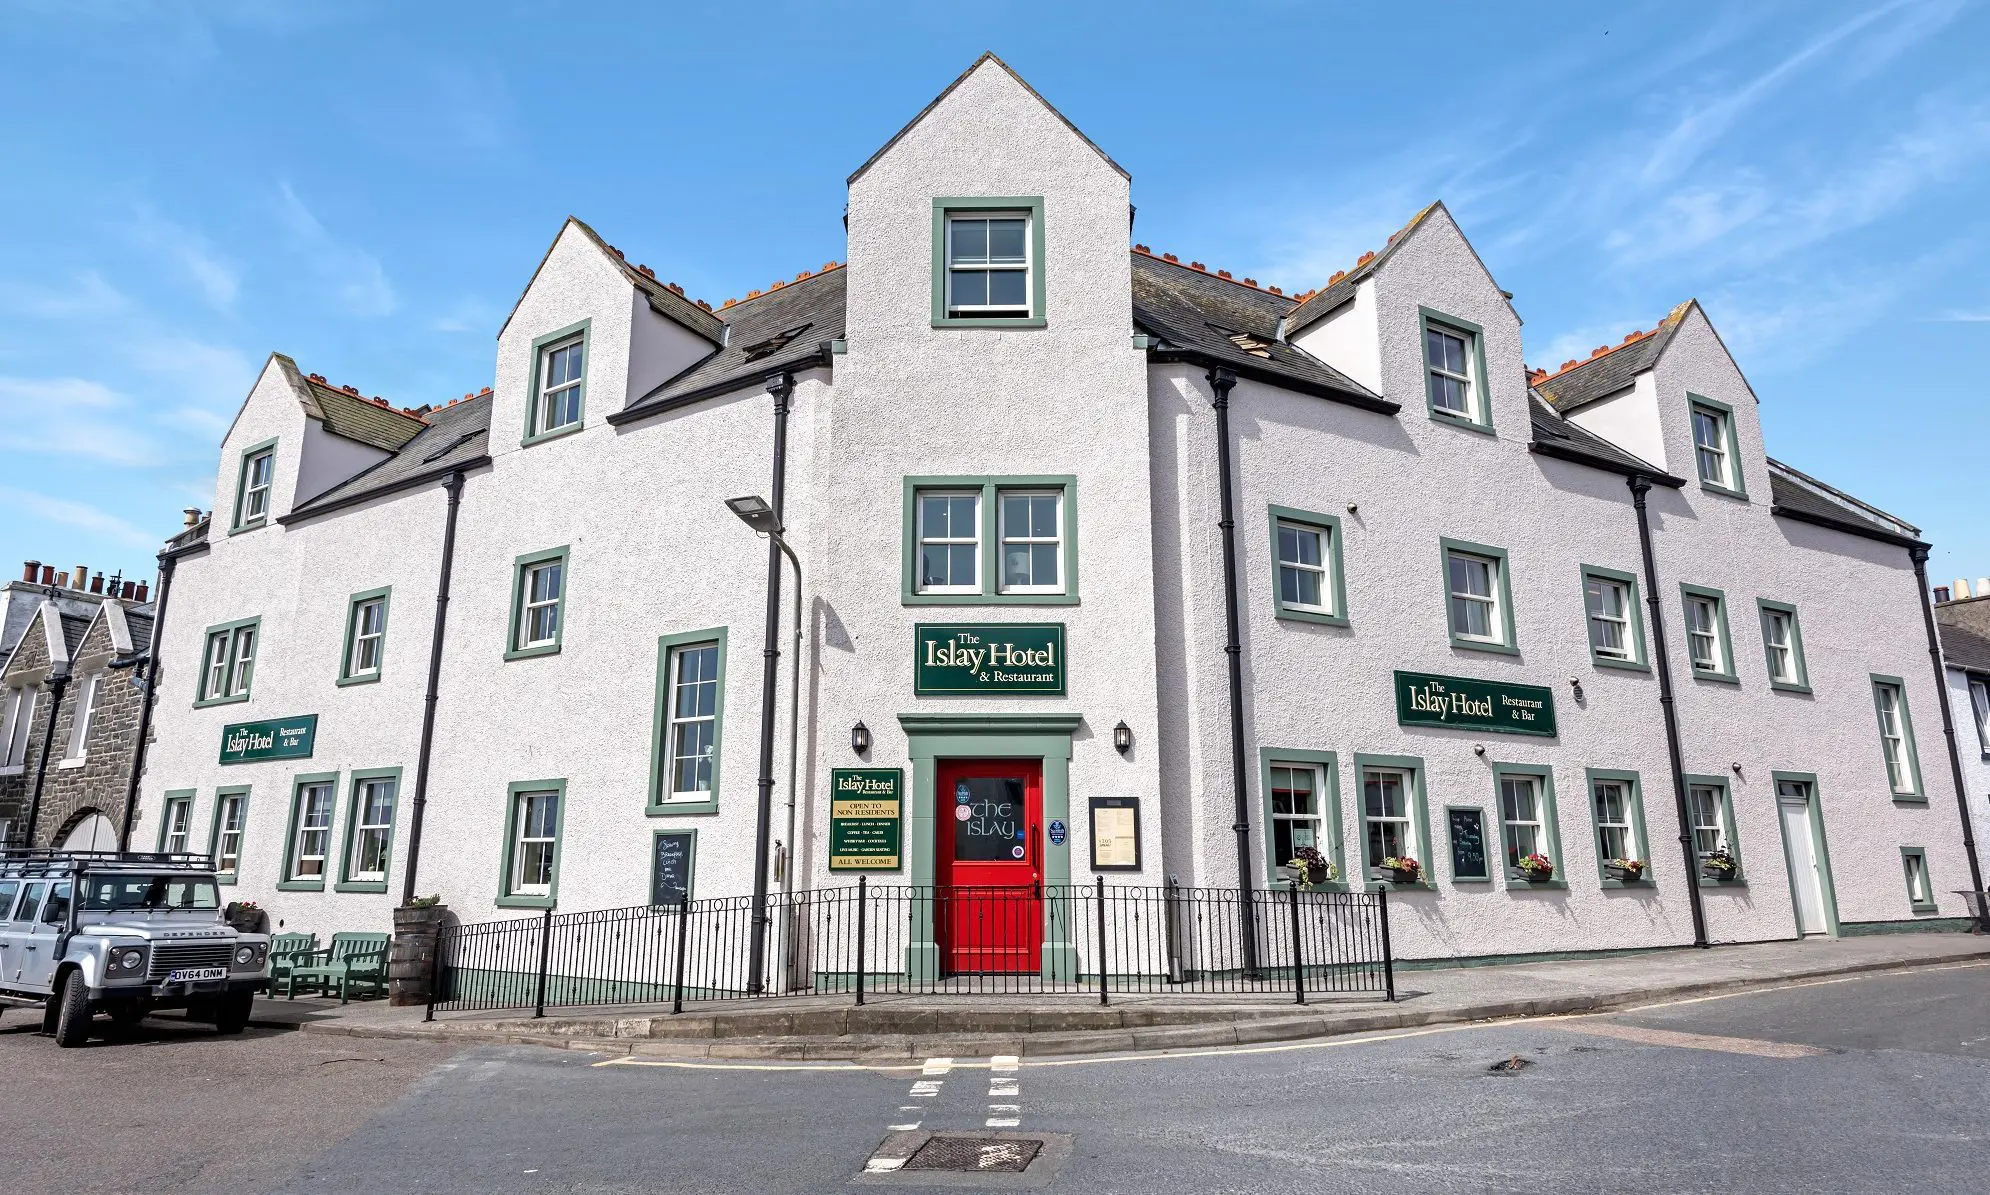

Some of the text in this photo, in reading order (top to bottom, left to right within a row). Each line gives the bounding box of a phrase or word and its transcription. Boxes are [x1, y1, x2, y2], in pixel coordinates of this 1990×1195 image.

[958, 633, 980, 644] The
[925, 639, 1055, 675] Islay Hotel
[979, 671, 1054, 682] & Restaurant
[1430, 681, 1445, 693] The
[1409, 685, 1494, 720] Islay Hotel
[1502, 694, 1543, 709] Restaurant
[1511, 709, 1535, 721] & Bar
[240, 728, 248, 737] The
[279, 727, 307, 736] Restaurant
[226, 730, 274, 757] Islay Hotel
[283, 737, 299, 747] & Bar
[838, 777, 893, 794] Islay Hotel
[203, 969, 222, 978] ONM
